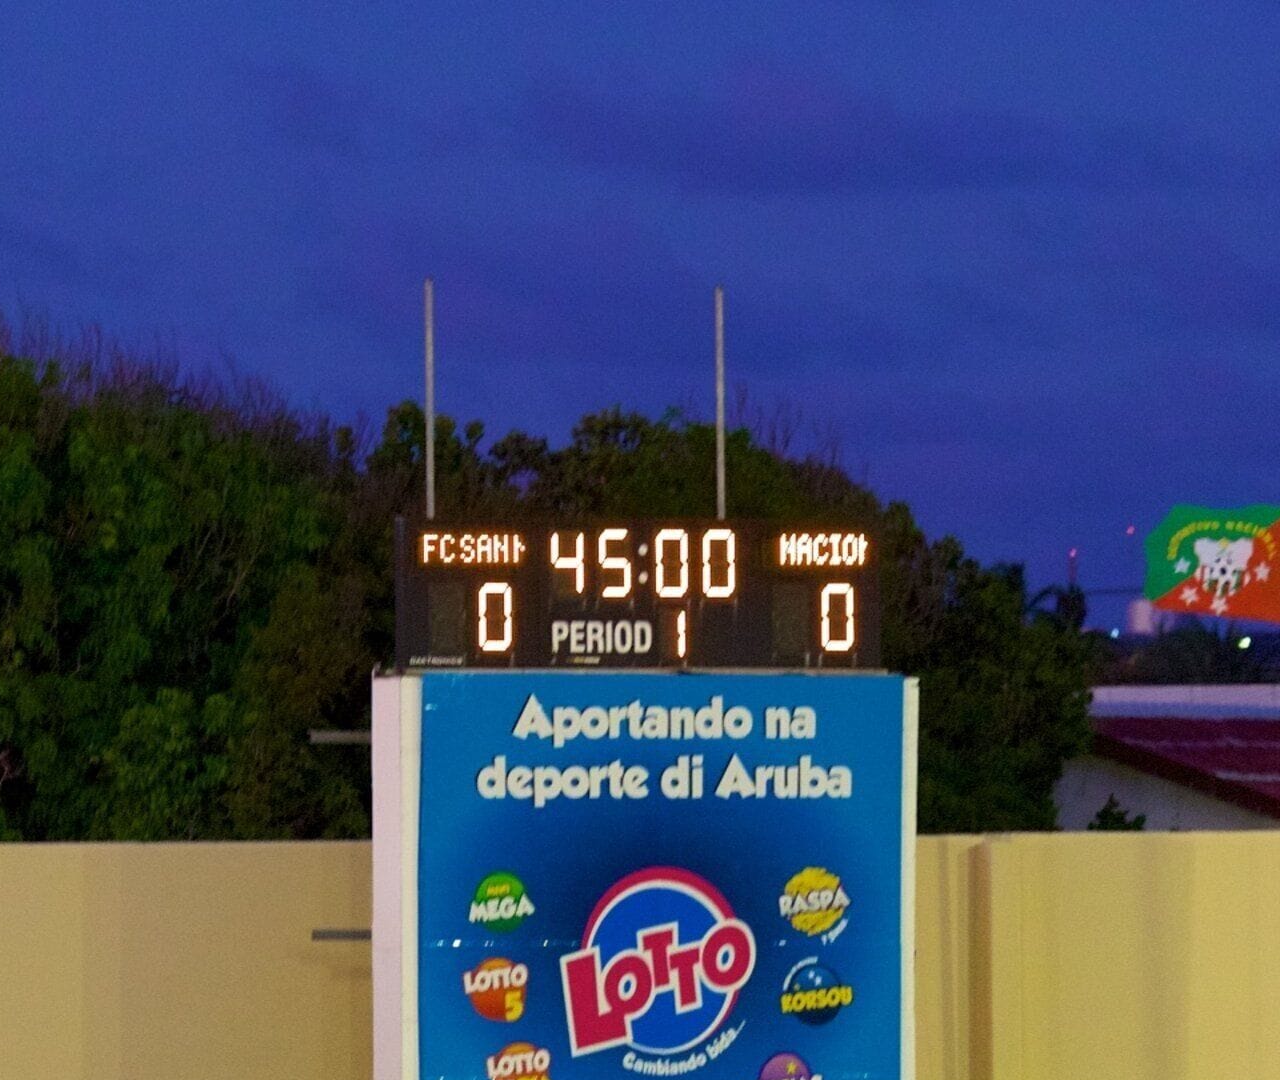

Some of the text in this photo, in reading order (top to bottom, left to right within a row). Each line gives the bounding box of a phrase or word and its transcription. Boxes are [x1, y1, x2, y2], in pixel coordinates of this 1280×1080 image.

[550, 528, 736, 598] 45:00
[478, 582, 513, 651] 0
[551, 609, 686, 658] PERIOD 1
[821, 583, 855, 651] 0
[513, 693, 816, 748] Aportando na
[476, 753, 853, 808] deporte di Aruba
[469, 893, 535, 923] MEGA
[779, 886, 851, 916] RASPA
[463, 963, 528, 994] LOTTO
[560, 918, 756, 1058] LOTTO
[504, 989, 524, 1022] 5
[780, 986, 853, 1013] KORSOU
[487, 1049, 551, 1079] LOTTO
[622, 1051, 707, 1077] Cambiando
